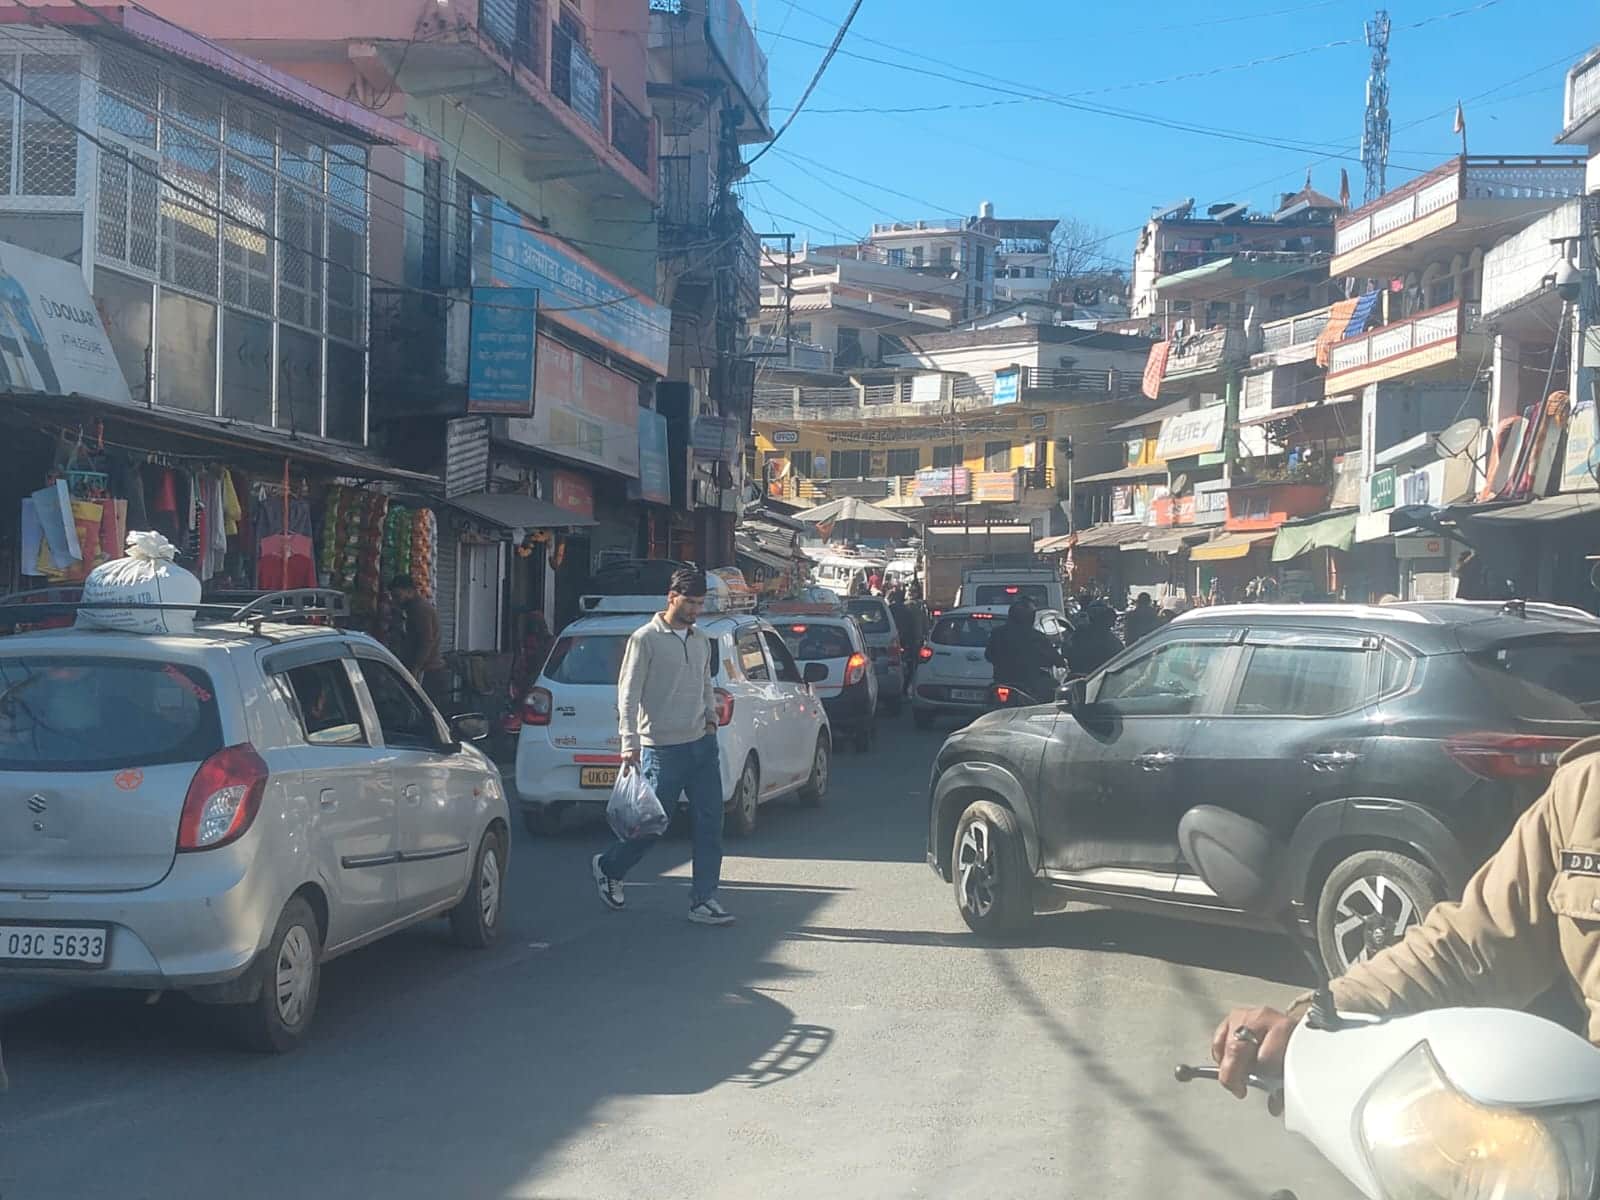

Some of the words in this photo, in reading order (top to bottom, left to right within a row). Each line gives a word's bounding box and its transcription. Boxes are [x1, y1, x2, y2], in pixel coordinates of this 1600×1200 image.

[51, 301, 97, 328] DOLLAR
[9, 934, 44, 955] 03C
[53, 935, 102, 957] 5633
